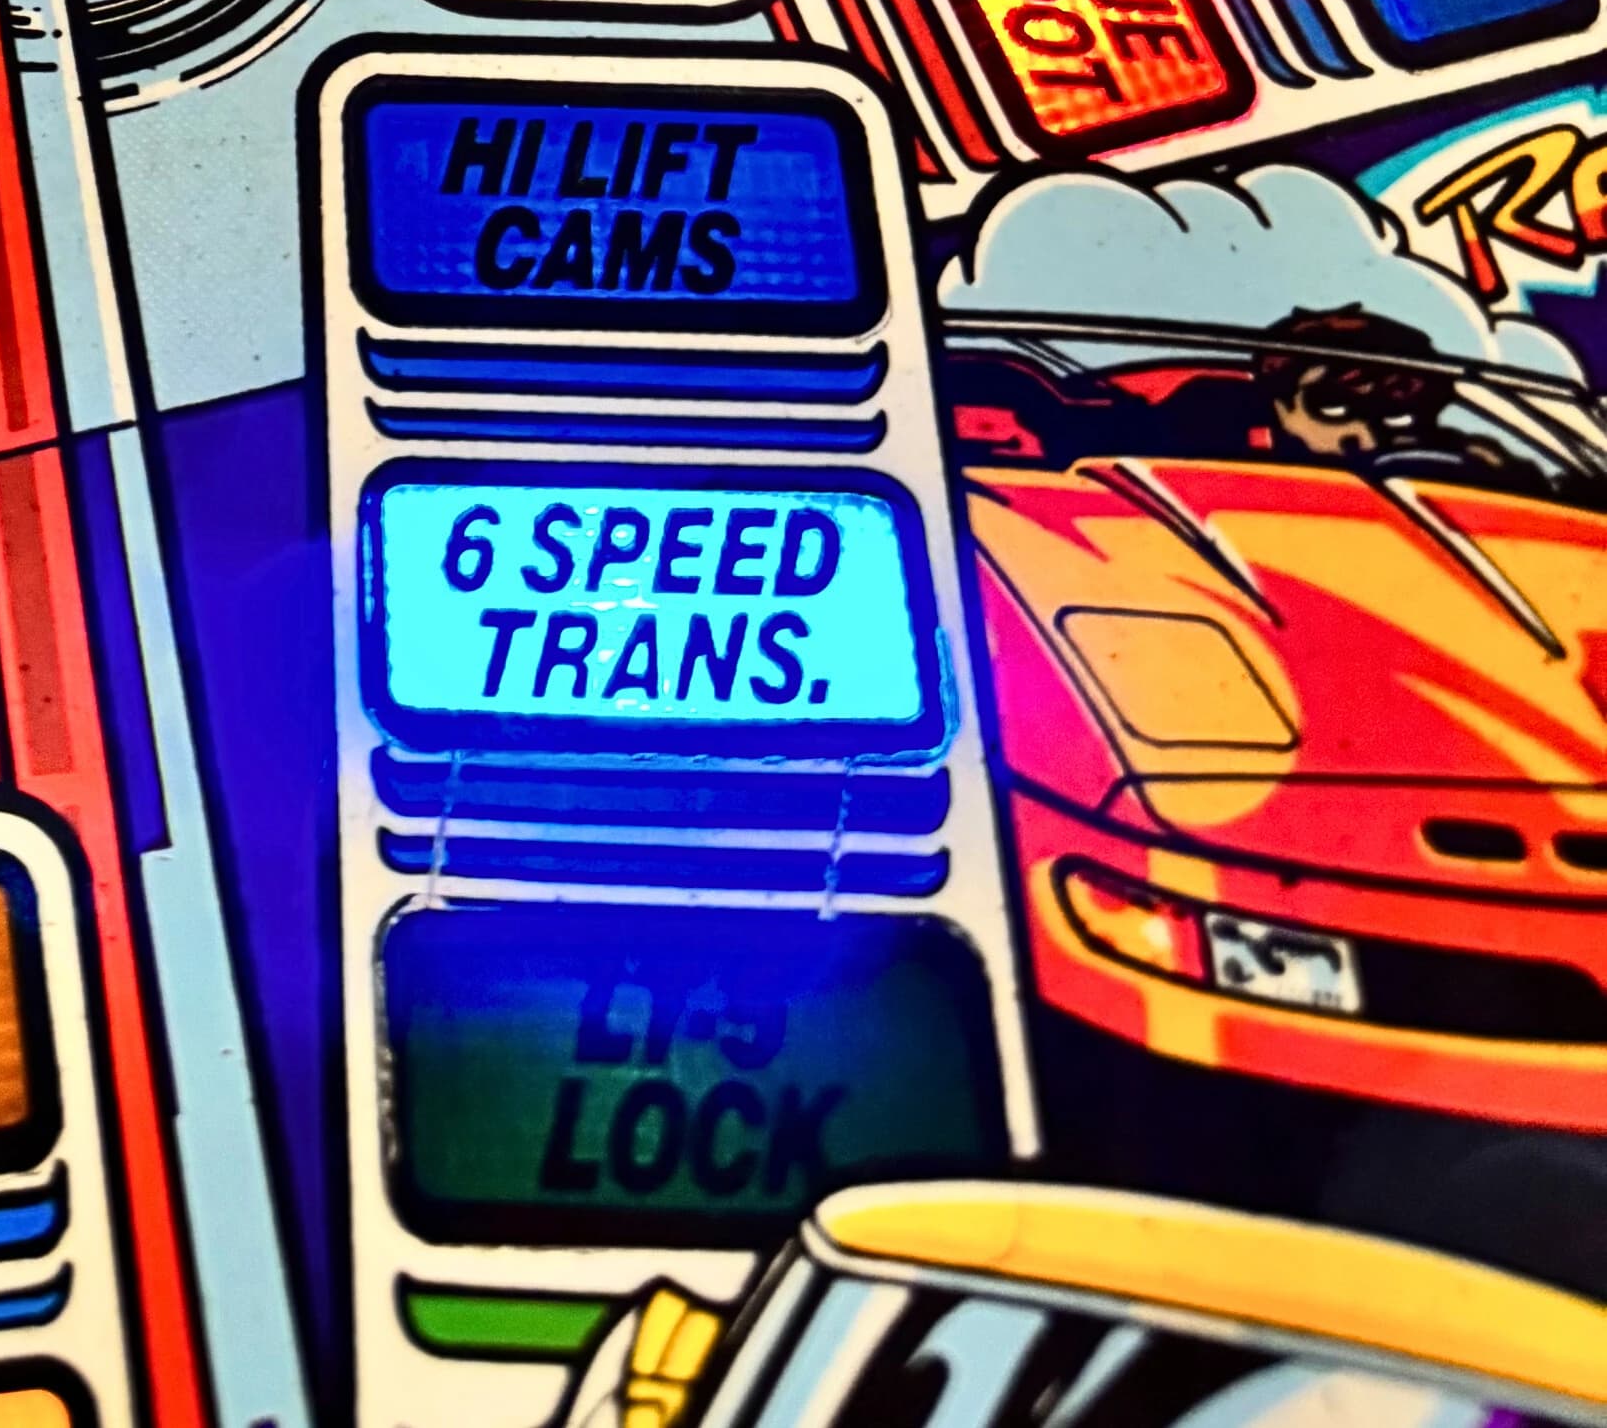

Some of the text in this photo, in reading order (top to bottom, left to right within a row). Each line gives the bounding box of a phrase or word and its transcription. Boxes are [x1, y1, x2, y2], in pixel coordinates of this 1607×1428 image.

[440, 116, 760, 203] HI LIFT
[472, 205, 743, 294] CAMS
[441, 501, 841, 597] 6 SPEED
[479, 606, 833, 706] TRANS.
[540, 1078, 846, 1195] LOCK
